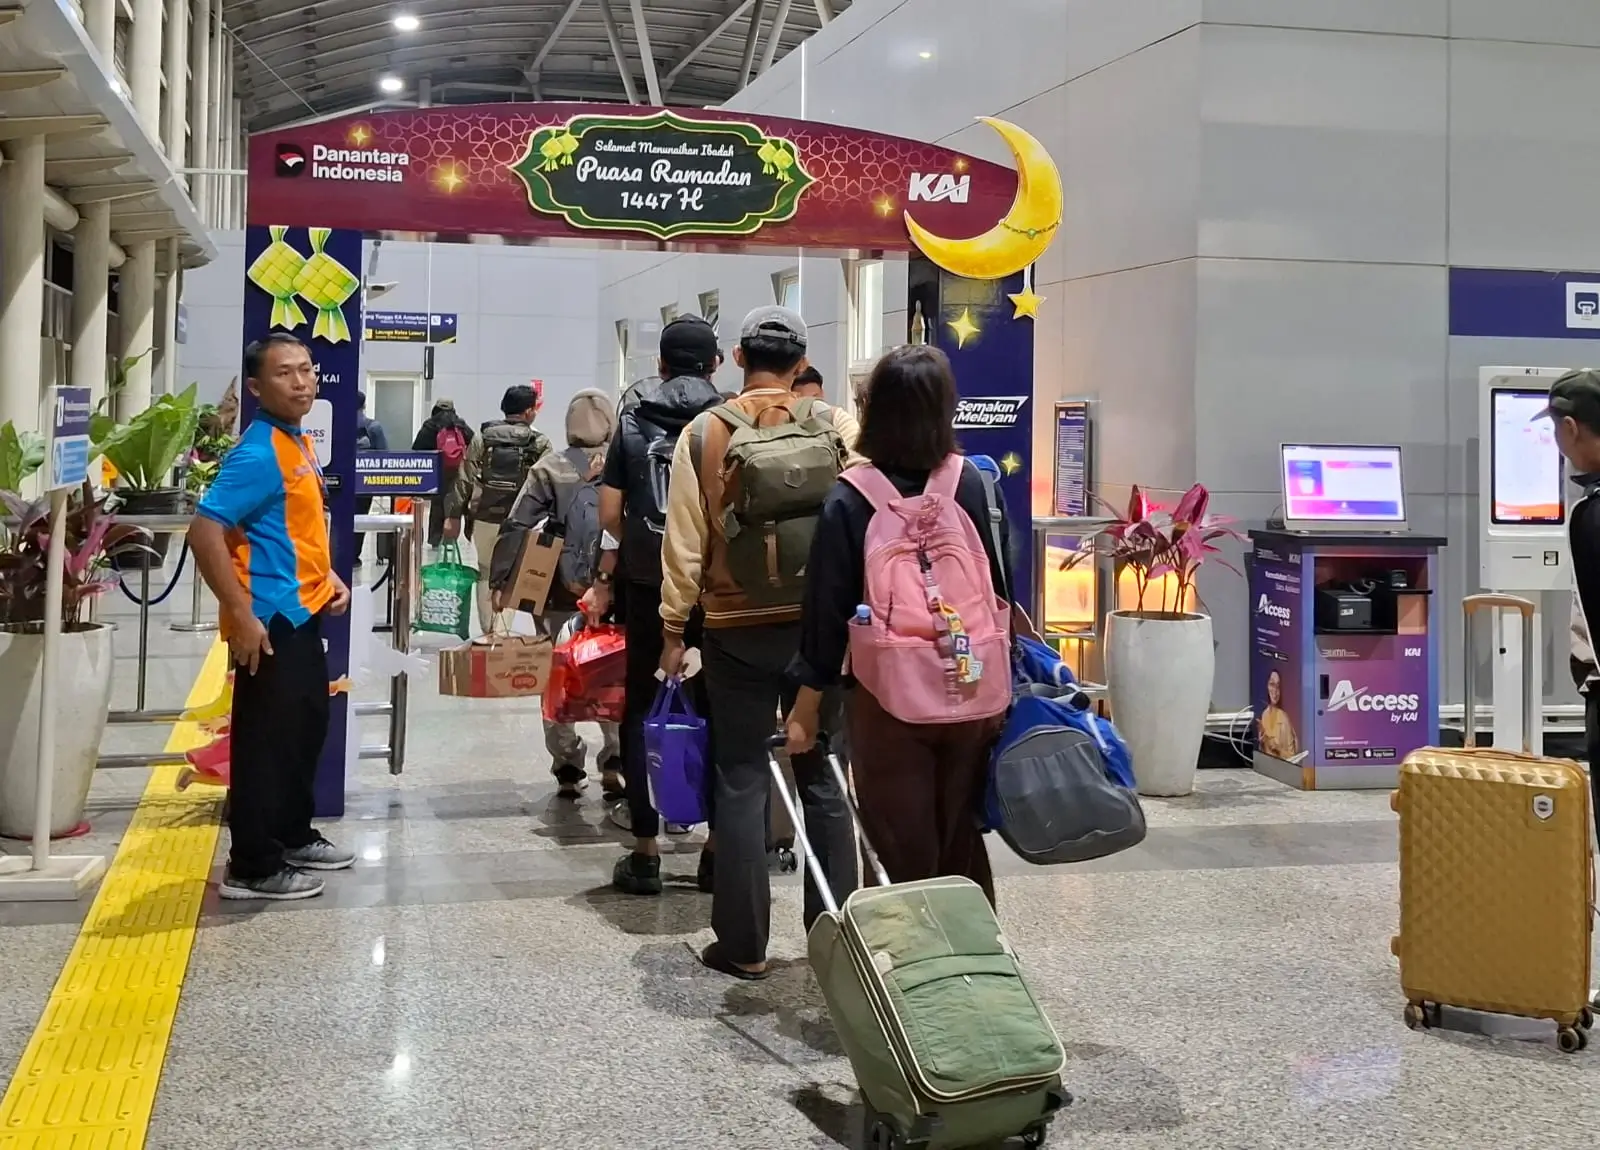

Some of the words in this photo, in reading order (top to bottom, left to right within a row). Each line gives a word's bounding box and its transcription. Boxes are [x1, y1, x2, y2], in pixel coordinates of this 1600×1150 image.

[312, 144, 409, 165] Danantara
[594, 140, 636, 153] Selamat
[638, 142, 699, 155] Menunaikan
[701, 144, 734, 157] Ibadah
[312, 161, 403, 182] Indonesia
[576, 156, 642, 182] Puasa
[650, 159, 752, 186] Ramadan
[908, 172, 971, 203] KAI
[620, 191, 672, 210] 1447
[676, 187, 704, 212] H
[322, 373, 340, 384] KAI
[956, 400, 1015, 414] Semakin
[957, 410, 1018, 425] Melayani
[382, 458, 433, 469] PENGANTAR
[363, 475, 403, 485] PASSENGER
[404, 475, 423, 485] ONLY
[1258, 593, 1291, 619] Access
[1404, 647, 1422, 657] KAI
[1327, 679, 1420, 712] Access
[1390, 712, 1402, 724] by
[1402, 712, 1418, 722] KAI
